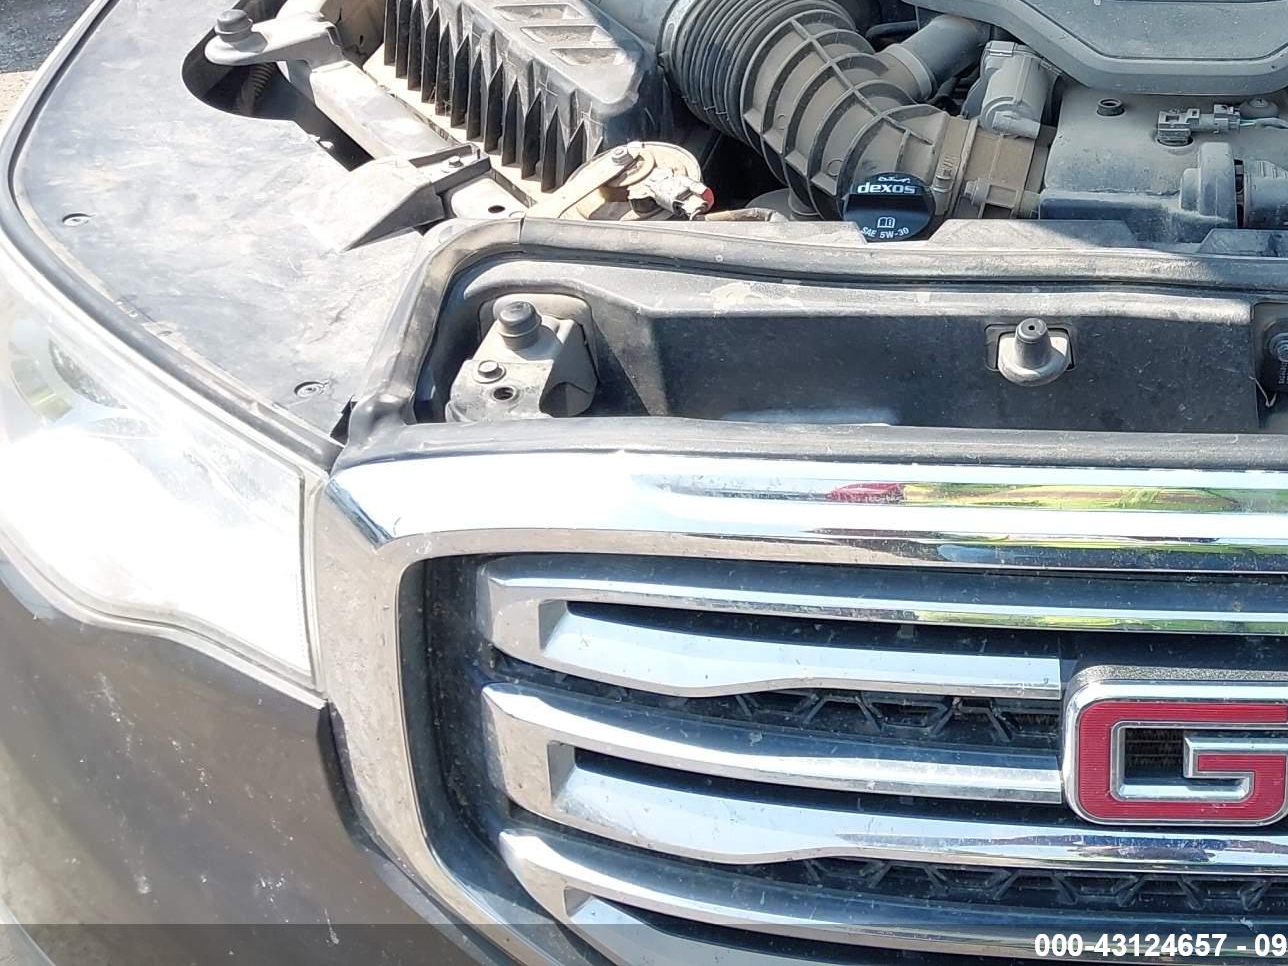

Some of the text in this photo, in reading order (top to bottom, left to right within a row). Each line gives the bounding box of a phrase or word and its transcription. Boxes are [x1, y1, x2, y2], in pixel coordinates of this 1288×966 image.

[857, 182, 915, 194] dexos
[861, 227, 910, 239] SAE 5W-30
